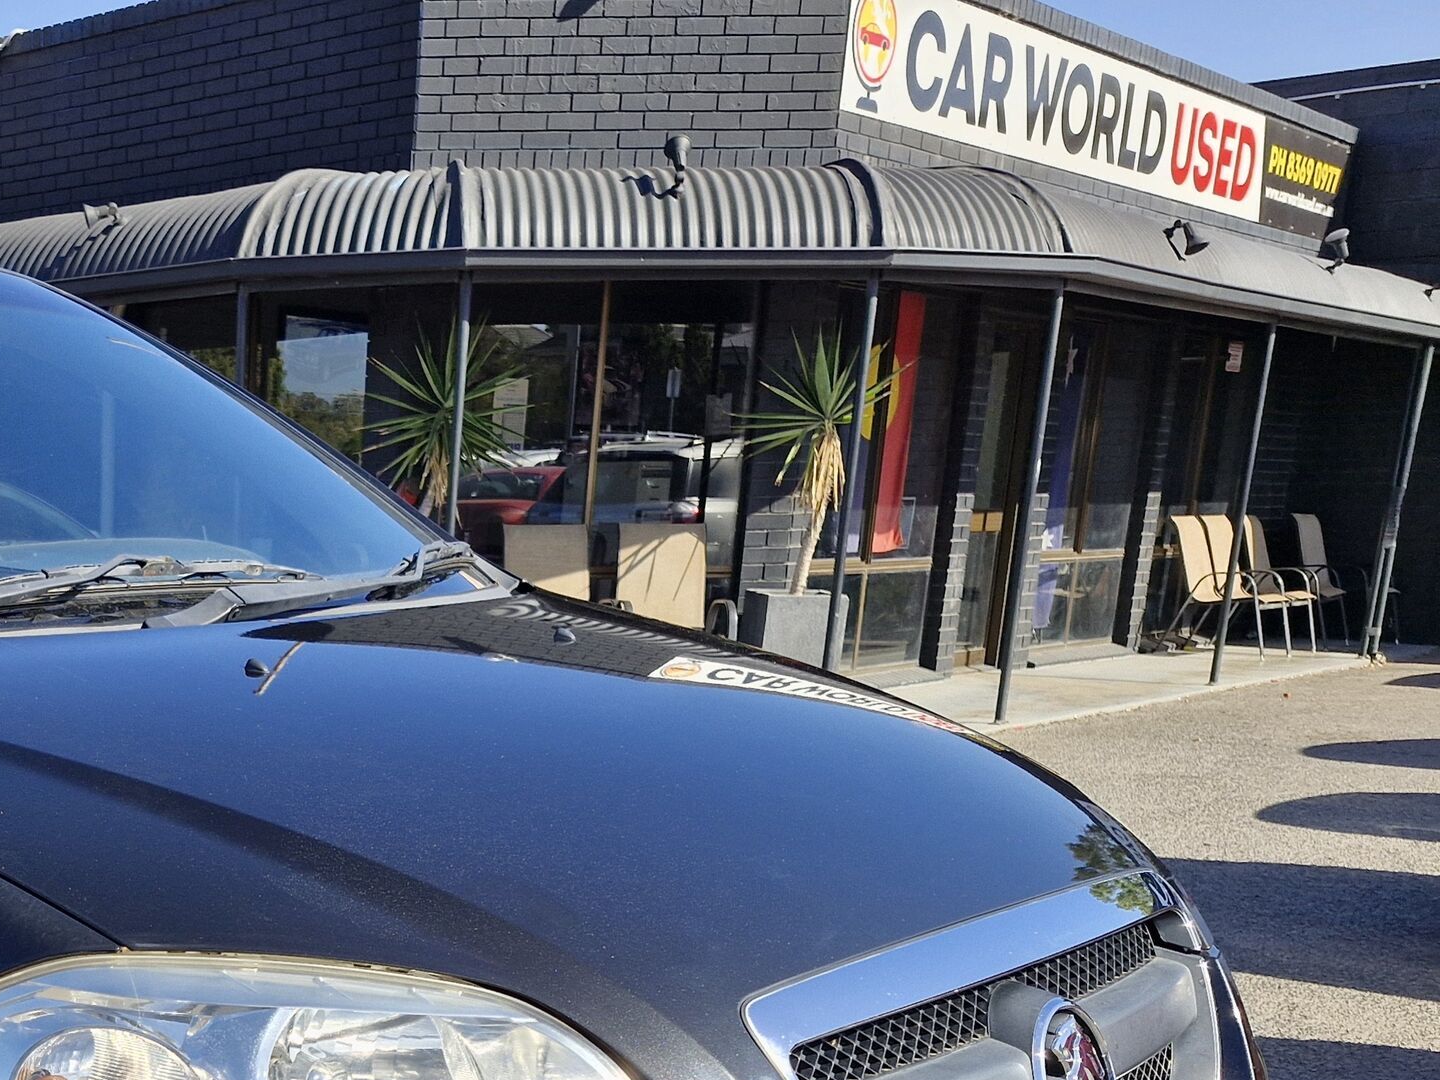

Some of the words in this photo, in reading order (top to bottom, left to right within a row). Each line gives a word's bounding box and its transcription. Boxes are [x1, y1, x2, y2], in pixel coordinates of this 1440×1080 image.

[906, 10, 1013, 134] CAR
[1026, 44, 1167, 175] WORLD
[1171, 102, 1256, 201] USED
[1268, 144, 1288, 177] PH
[1286, 151, 1315, 186] 8369
[1313, 161, 1342, 195] 0977
